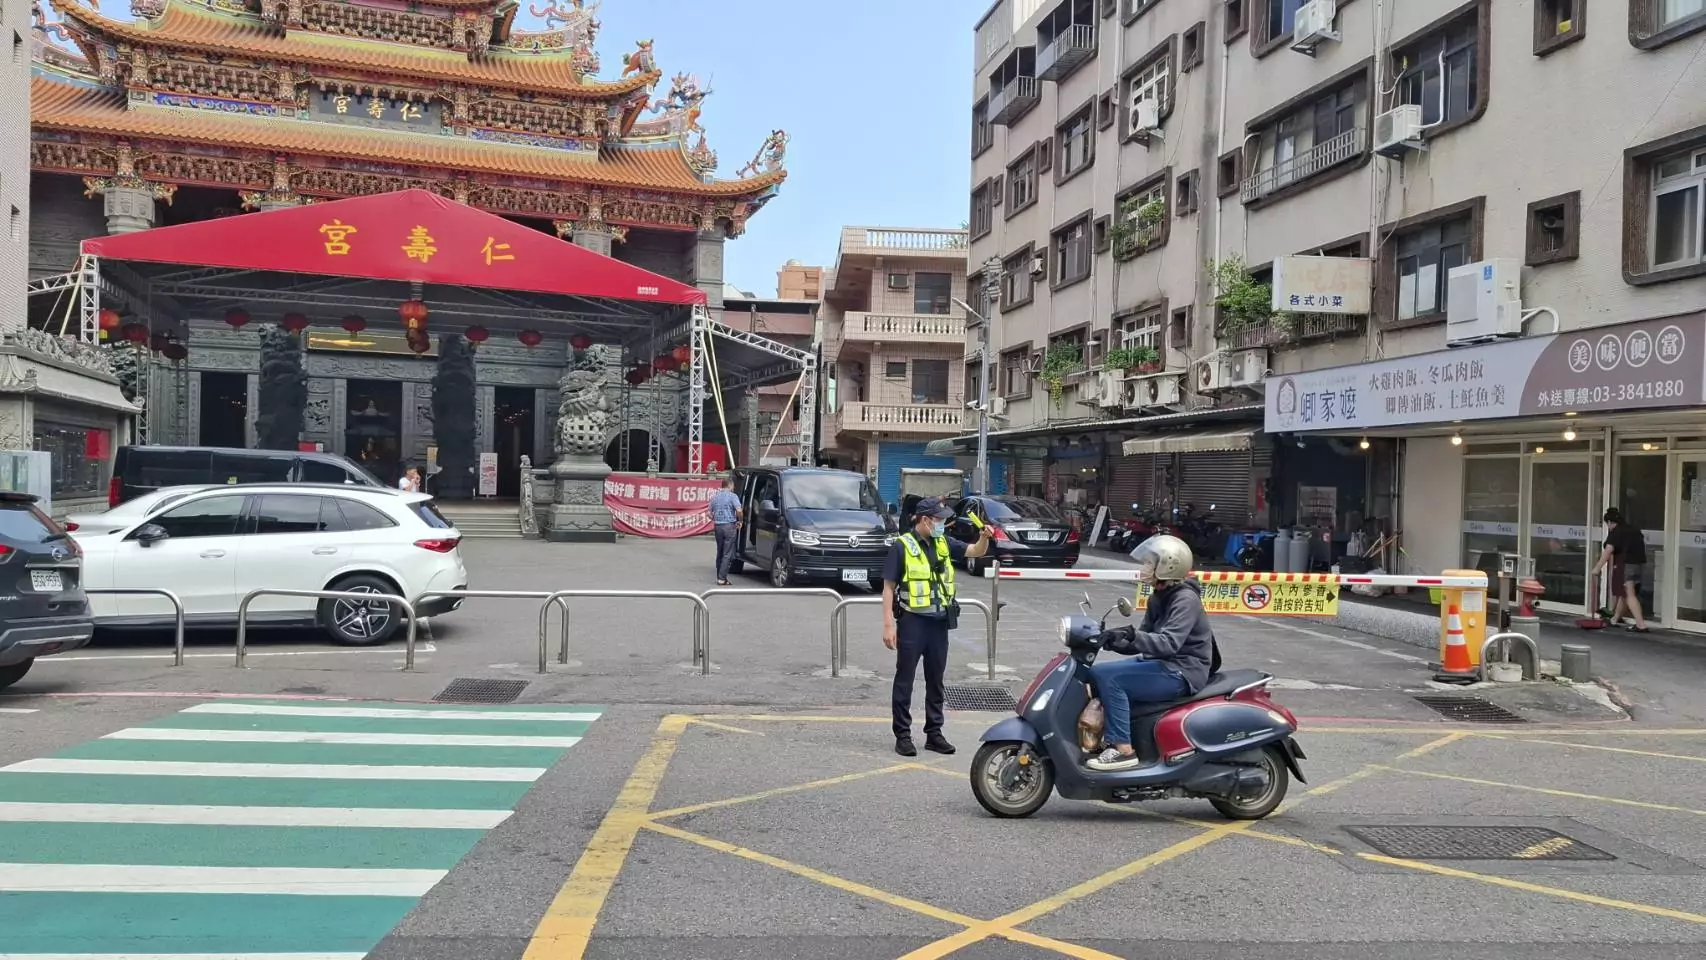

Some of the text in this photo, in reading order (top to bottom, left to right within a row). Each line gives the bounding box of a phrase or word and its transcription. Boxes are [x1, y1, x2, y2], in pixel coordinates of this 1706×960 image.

[1290, 294, 1343, 307] 各式小菜
[1573, 333, 1679, 367] 美味便當
[1301, 385, 1357, 424] 卿家嬤
[1272, 598, 1325, 613] 請按鈴告知
